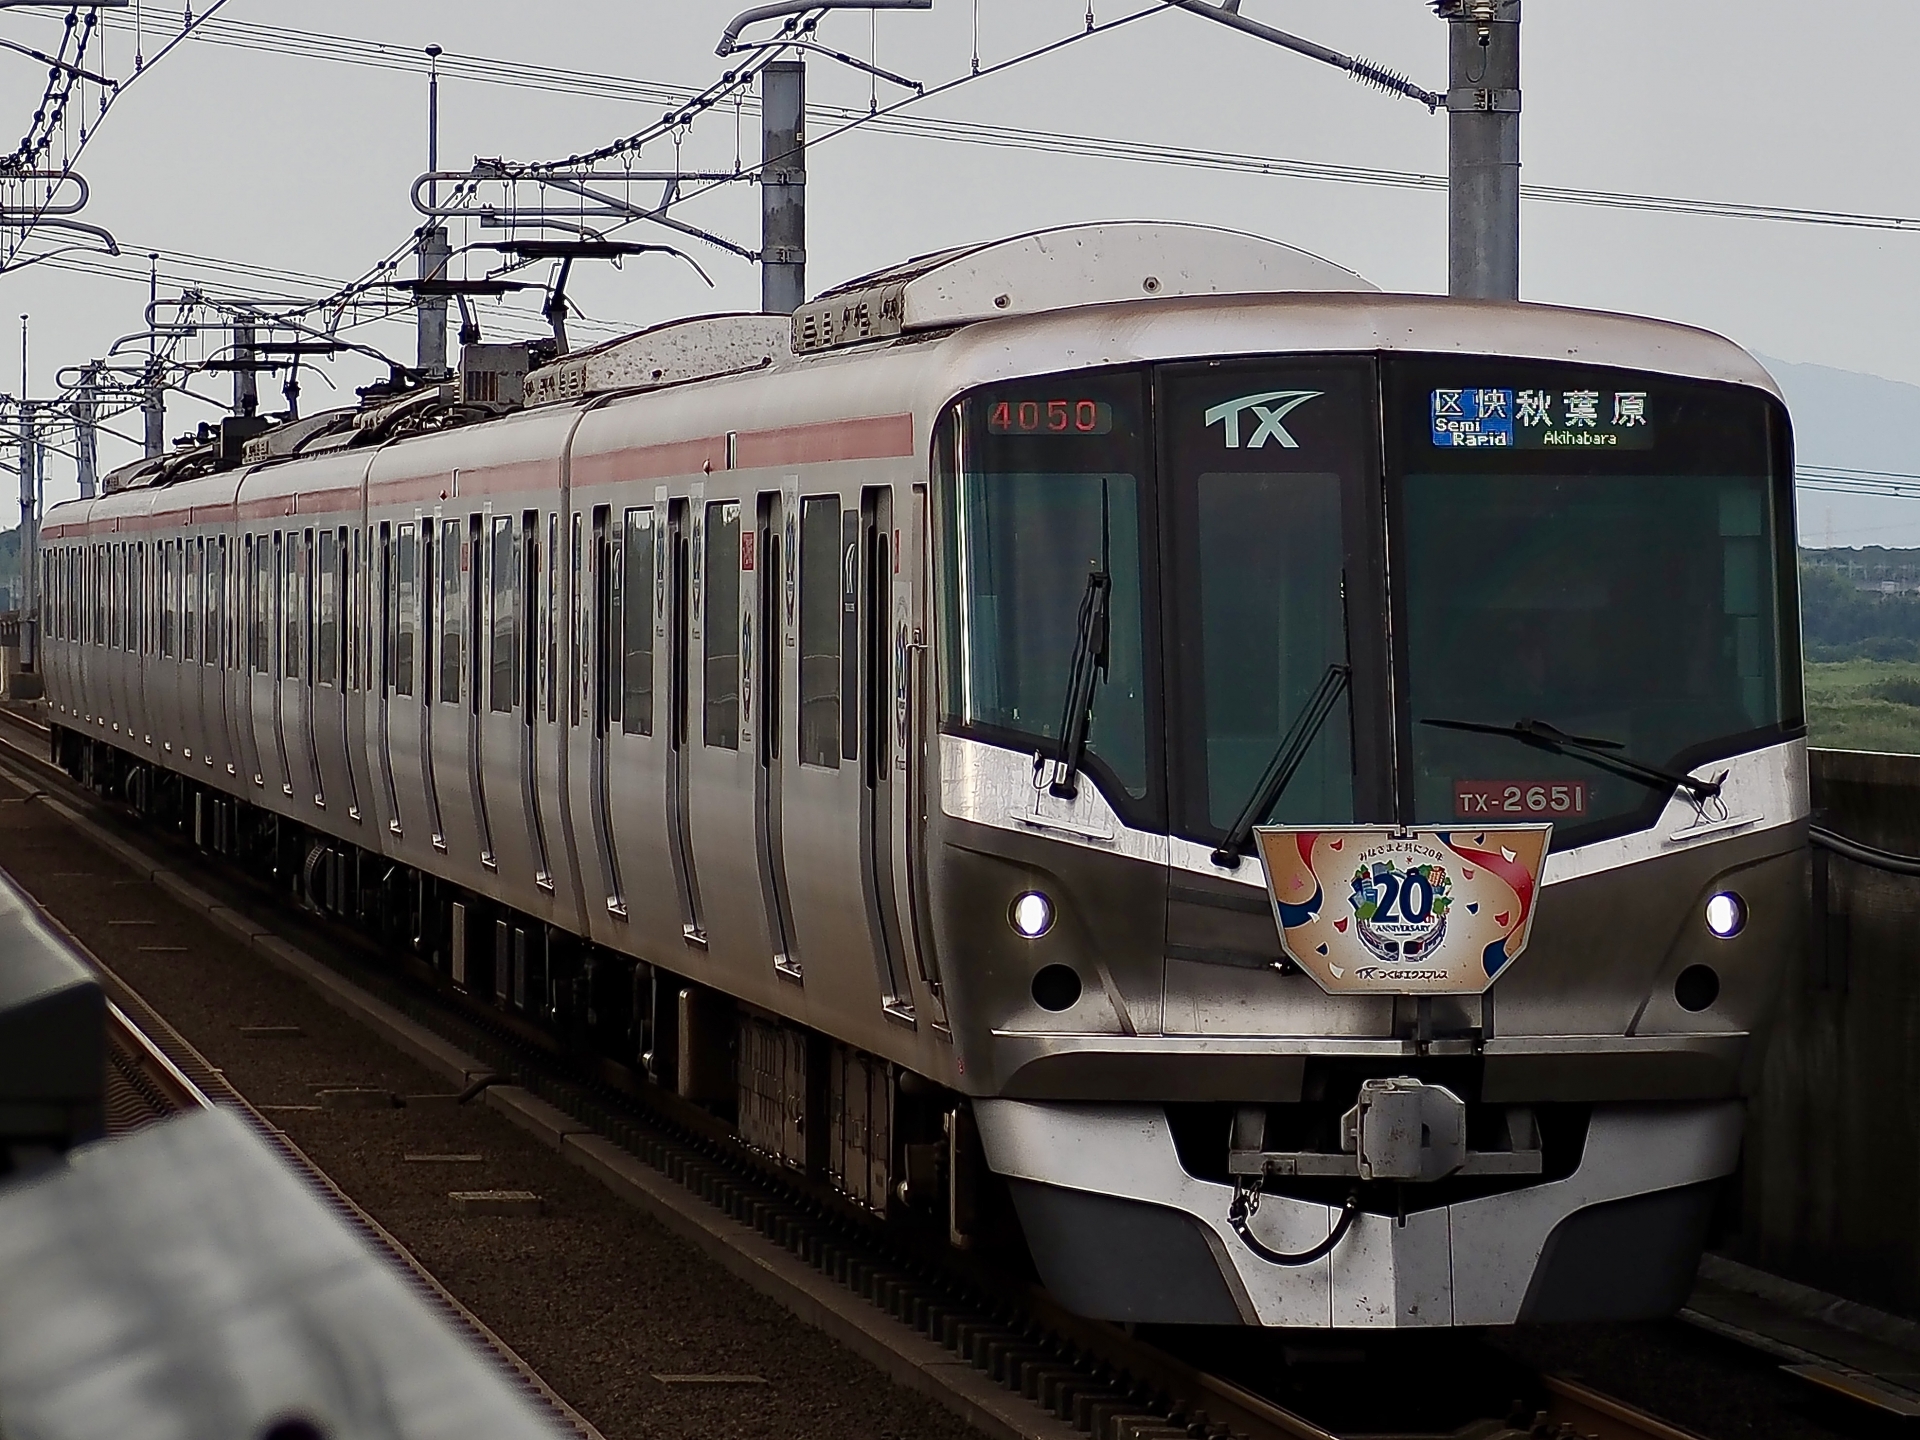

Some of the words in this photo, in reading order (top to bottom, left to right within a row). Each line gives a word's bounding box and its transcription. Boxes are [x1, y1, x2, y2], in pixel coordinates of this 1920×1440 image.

[1434, 389, 1506, 418] 区快
[1515, 390, 1648, 427] 秋葉原
[991, 400, 1098, 432] 4050
[1205, 390, 1325, 449] TX
[1434, 417, 1481, 432] Semi
[1452, 431, 1507, 447] Rapid
[1542, 430, 1618, 446] Akihabara
[1459, 786, 1582, 812] TX-2651
[1375, 924, 1431, 933] ANNIVERSARY
[1355, 966, 1379, 980] TX
